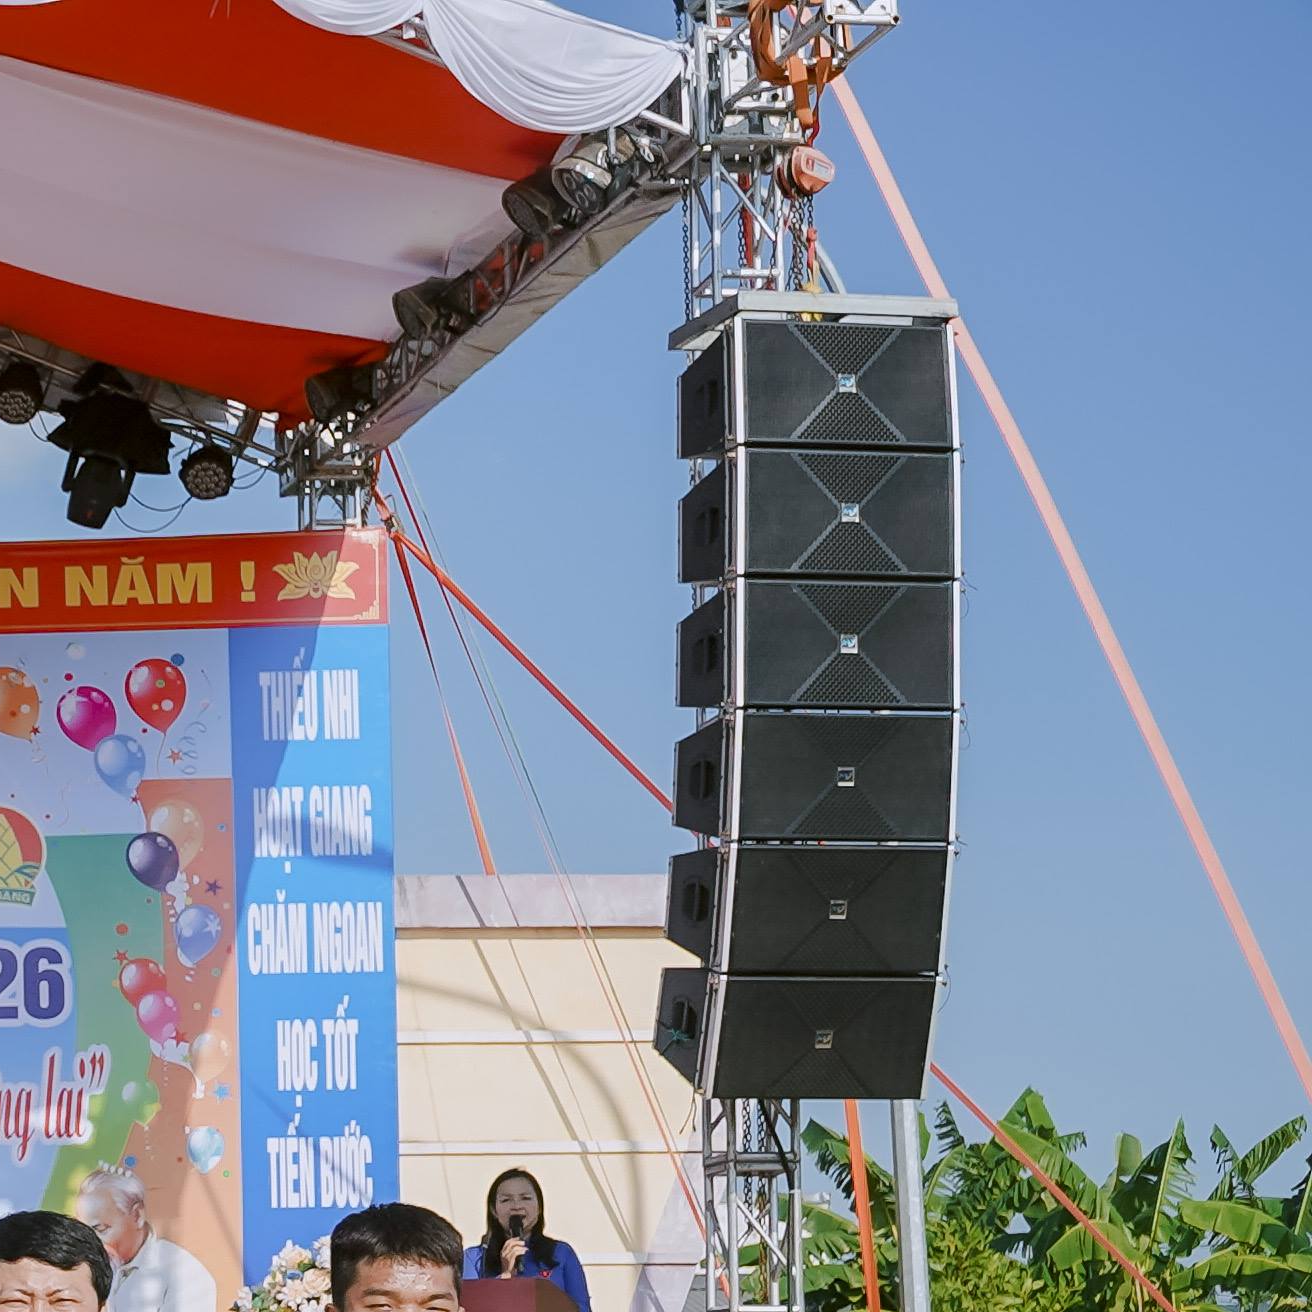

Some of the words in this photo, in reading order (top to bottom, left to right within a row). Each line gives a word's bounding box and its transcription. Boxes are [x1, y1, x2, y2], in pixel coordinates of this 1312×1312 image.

[65, 557, 212, 606] NĂM
[241, 561, 255, 602] !
[260, 649, 319, 741] THIẾU
[323, 670, 359, 739] NHI
[254, 786, 304, 873] HOẠT
[309, 785, 372, 855] GIANG
[248, 890, 307, 975] CHĂM
[313, 902, 383, 973] NGOAN
[43, 1051, 104, 1139] lai”
[277, 1019, 318, 1107] HỌC
[322, 995, 358, 1090] TỐT
[267, 1113, 315, 1208] TIẾN
[320, 1120, 373, 1208] BƯỚC
